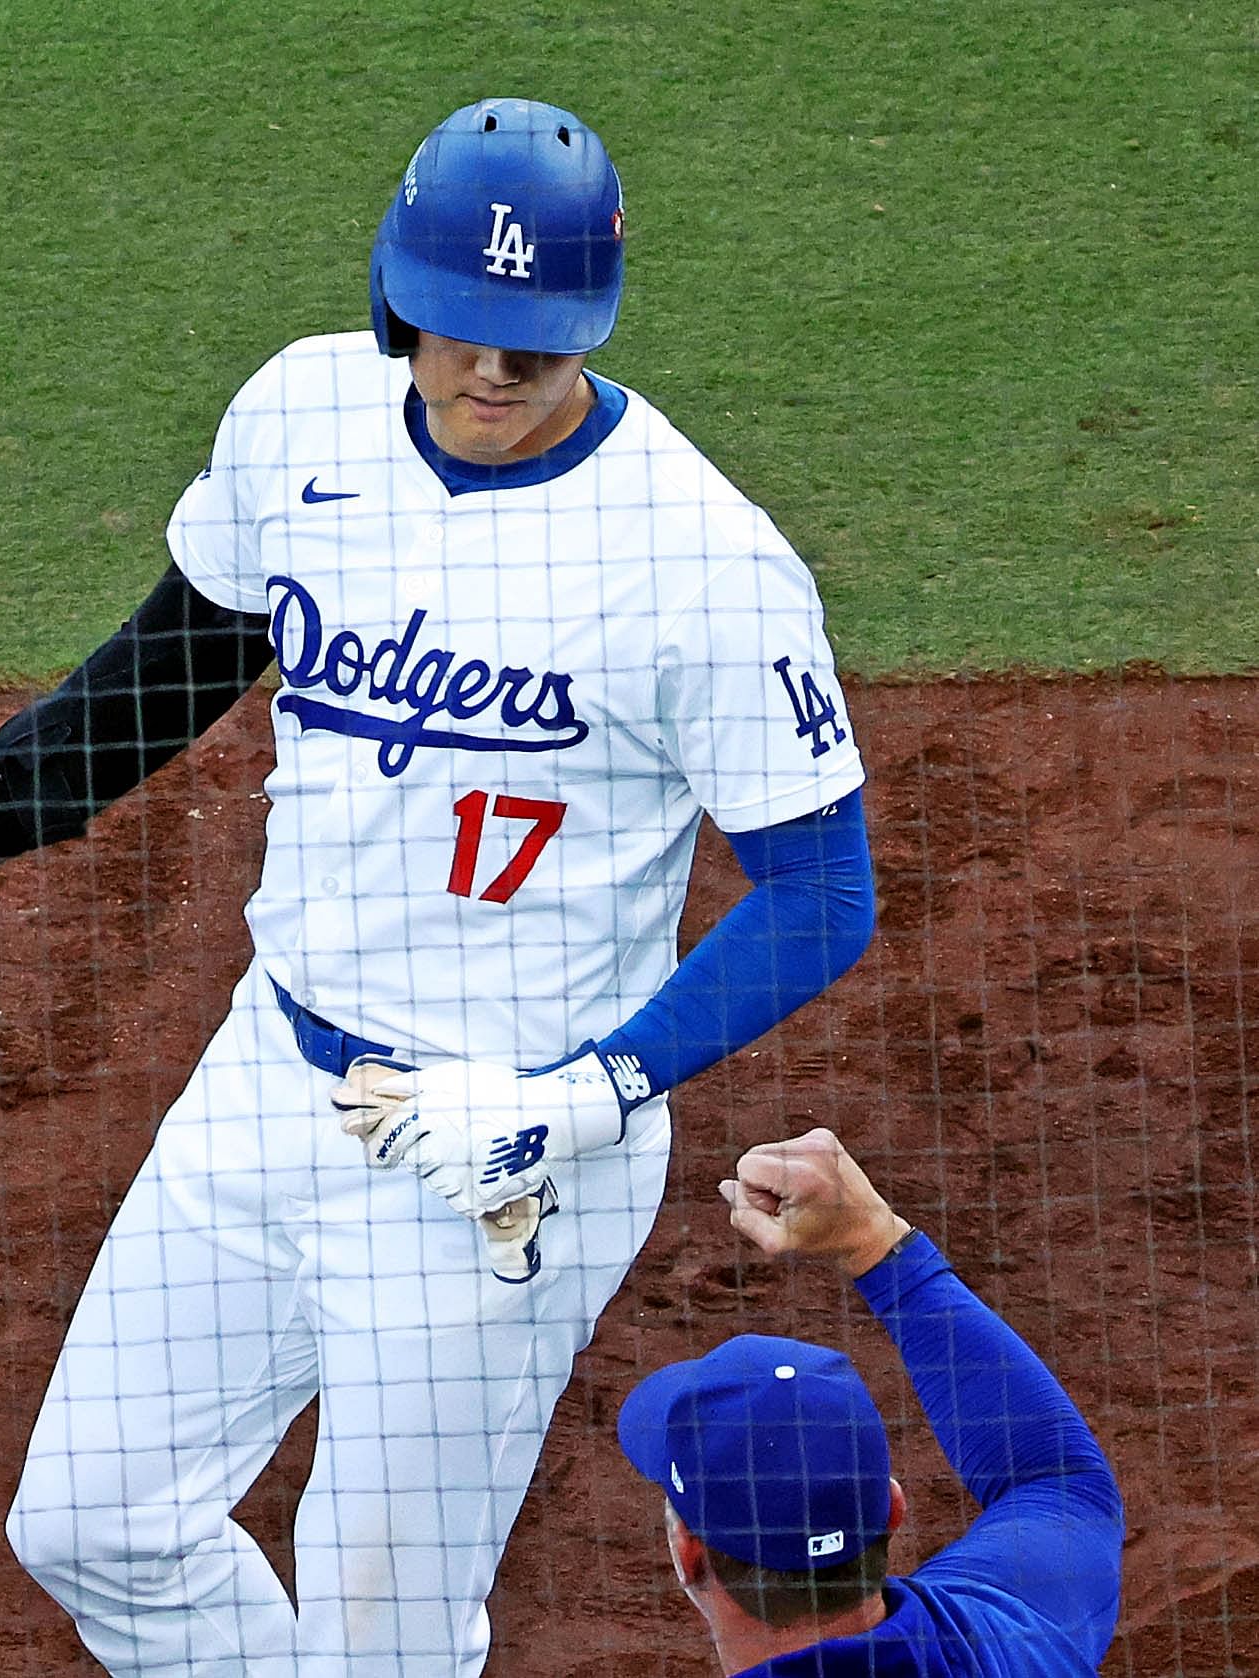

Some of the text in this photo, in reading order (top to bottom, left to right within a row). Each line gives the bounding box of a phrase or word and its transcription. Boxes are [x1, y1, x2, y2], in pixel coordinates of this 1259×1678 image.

[483, 203, 534, 278] LA
[265, 574, 589, 777] Dodgers
[773, 655, 847, 759] LA
[447, 789, 567, 904] 17
